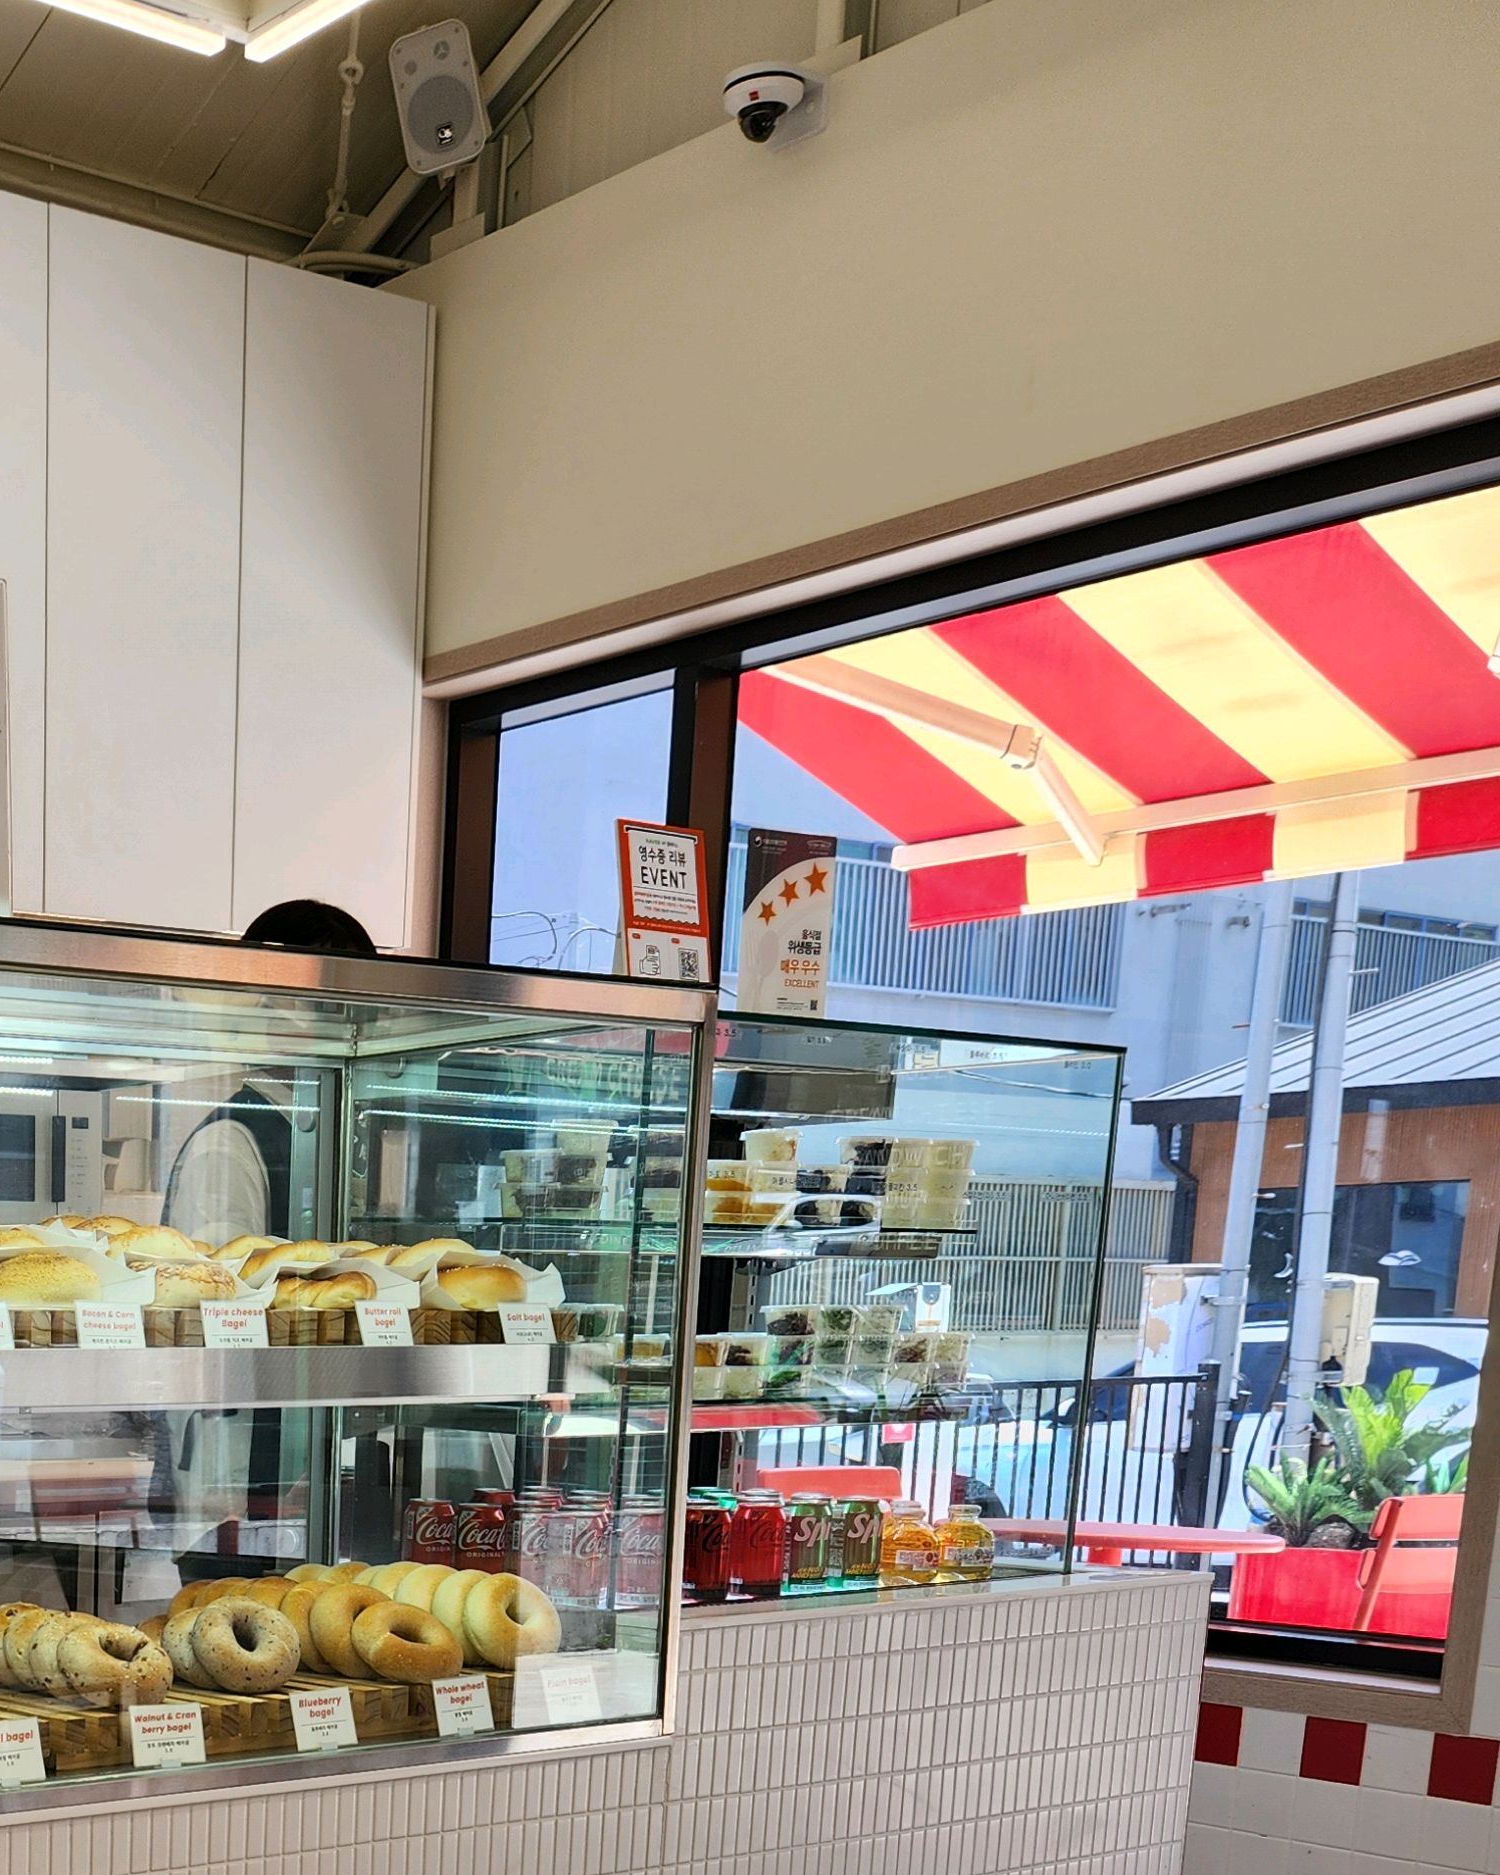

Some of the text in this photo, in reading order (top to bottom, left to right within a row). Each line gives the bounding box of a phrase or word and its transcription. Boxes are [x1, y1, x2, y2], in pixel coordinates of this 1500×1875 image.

[639, 845, 686, 868] 영수증 리뷰
[640, 866, 687, 889] EVENT
[785, 978, 820, 988] EXCELLENT
[203, 1308, 263, 1318] Triple cheese
[221, 1318, 247, 1330] Bagel
[436, 1681, 484, 1695] Whole wheat
[299, 1696, 342, 1708] Blueberry
[450, 1694, 472, 1705] bagel
[134, 1710, 197, 1723] Walnut & Cran
[309, 1707, 334, 1719] bagel
[142, 1722, 191, 1735] berry bagel
[4, 1730, 34, 1743] bagel
